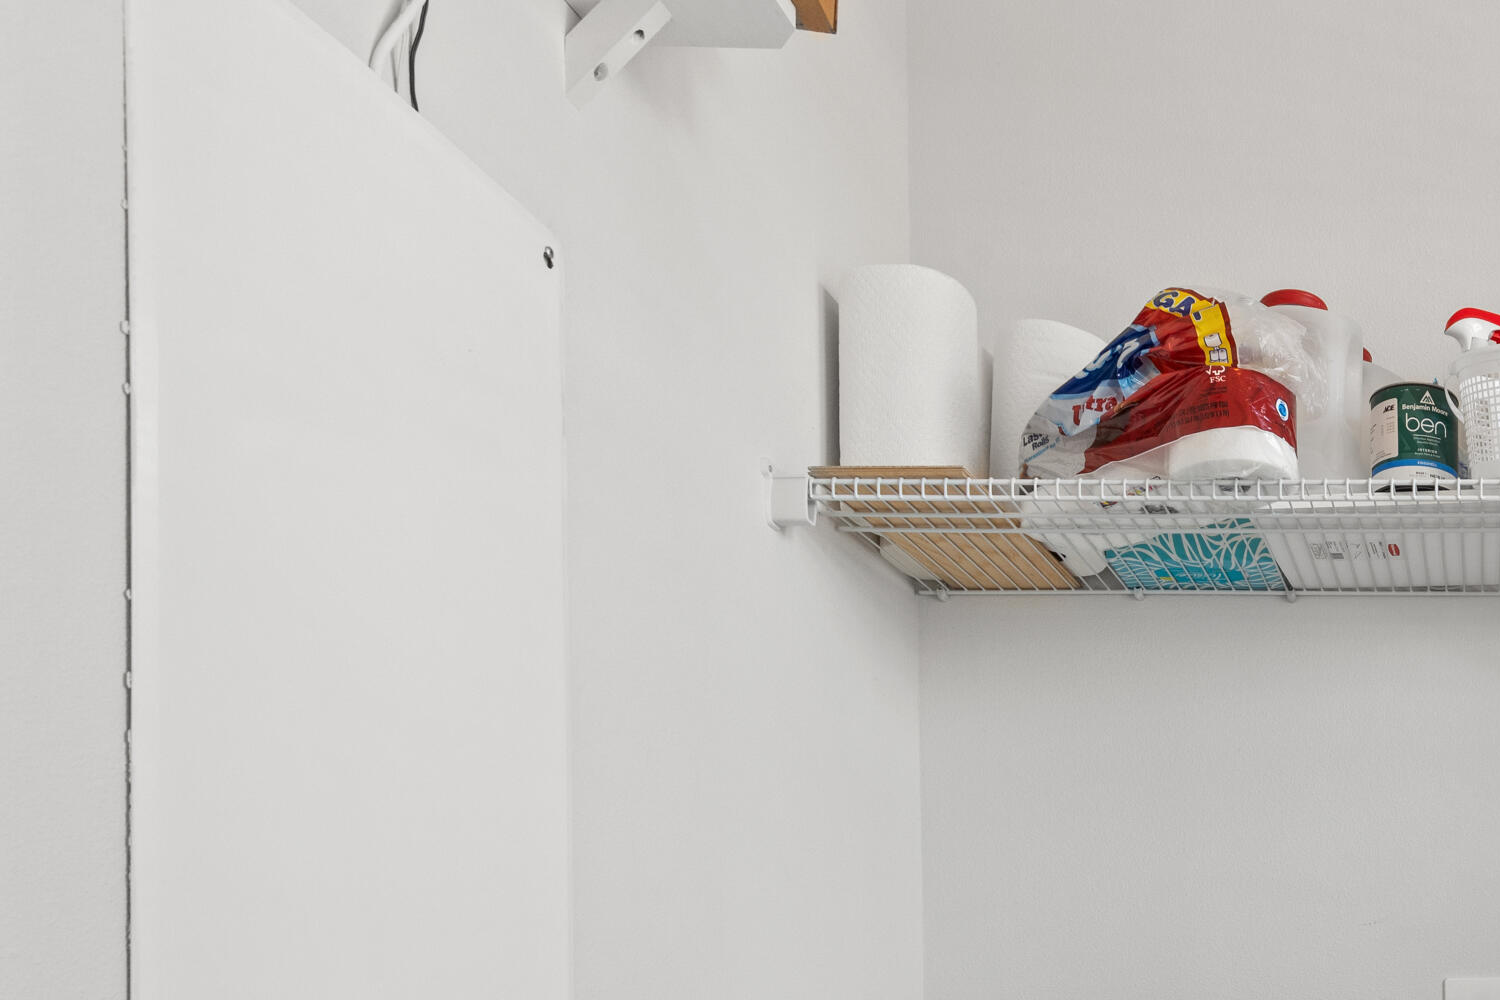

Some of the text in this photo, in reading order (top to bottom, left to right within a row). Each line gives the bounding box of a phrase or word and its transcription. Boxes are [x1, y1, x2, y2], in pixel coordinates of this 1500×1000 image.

[1209, 375, 1228, 384] FSC
[1383, 404, 1395, 413] ACE
[1401, 403, 1448, 417] Benjamin Moore
[1405, 412, 1447, 438] ben
